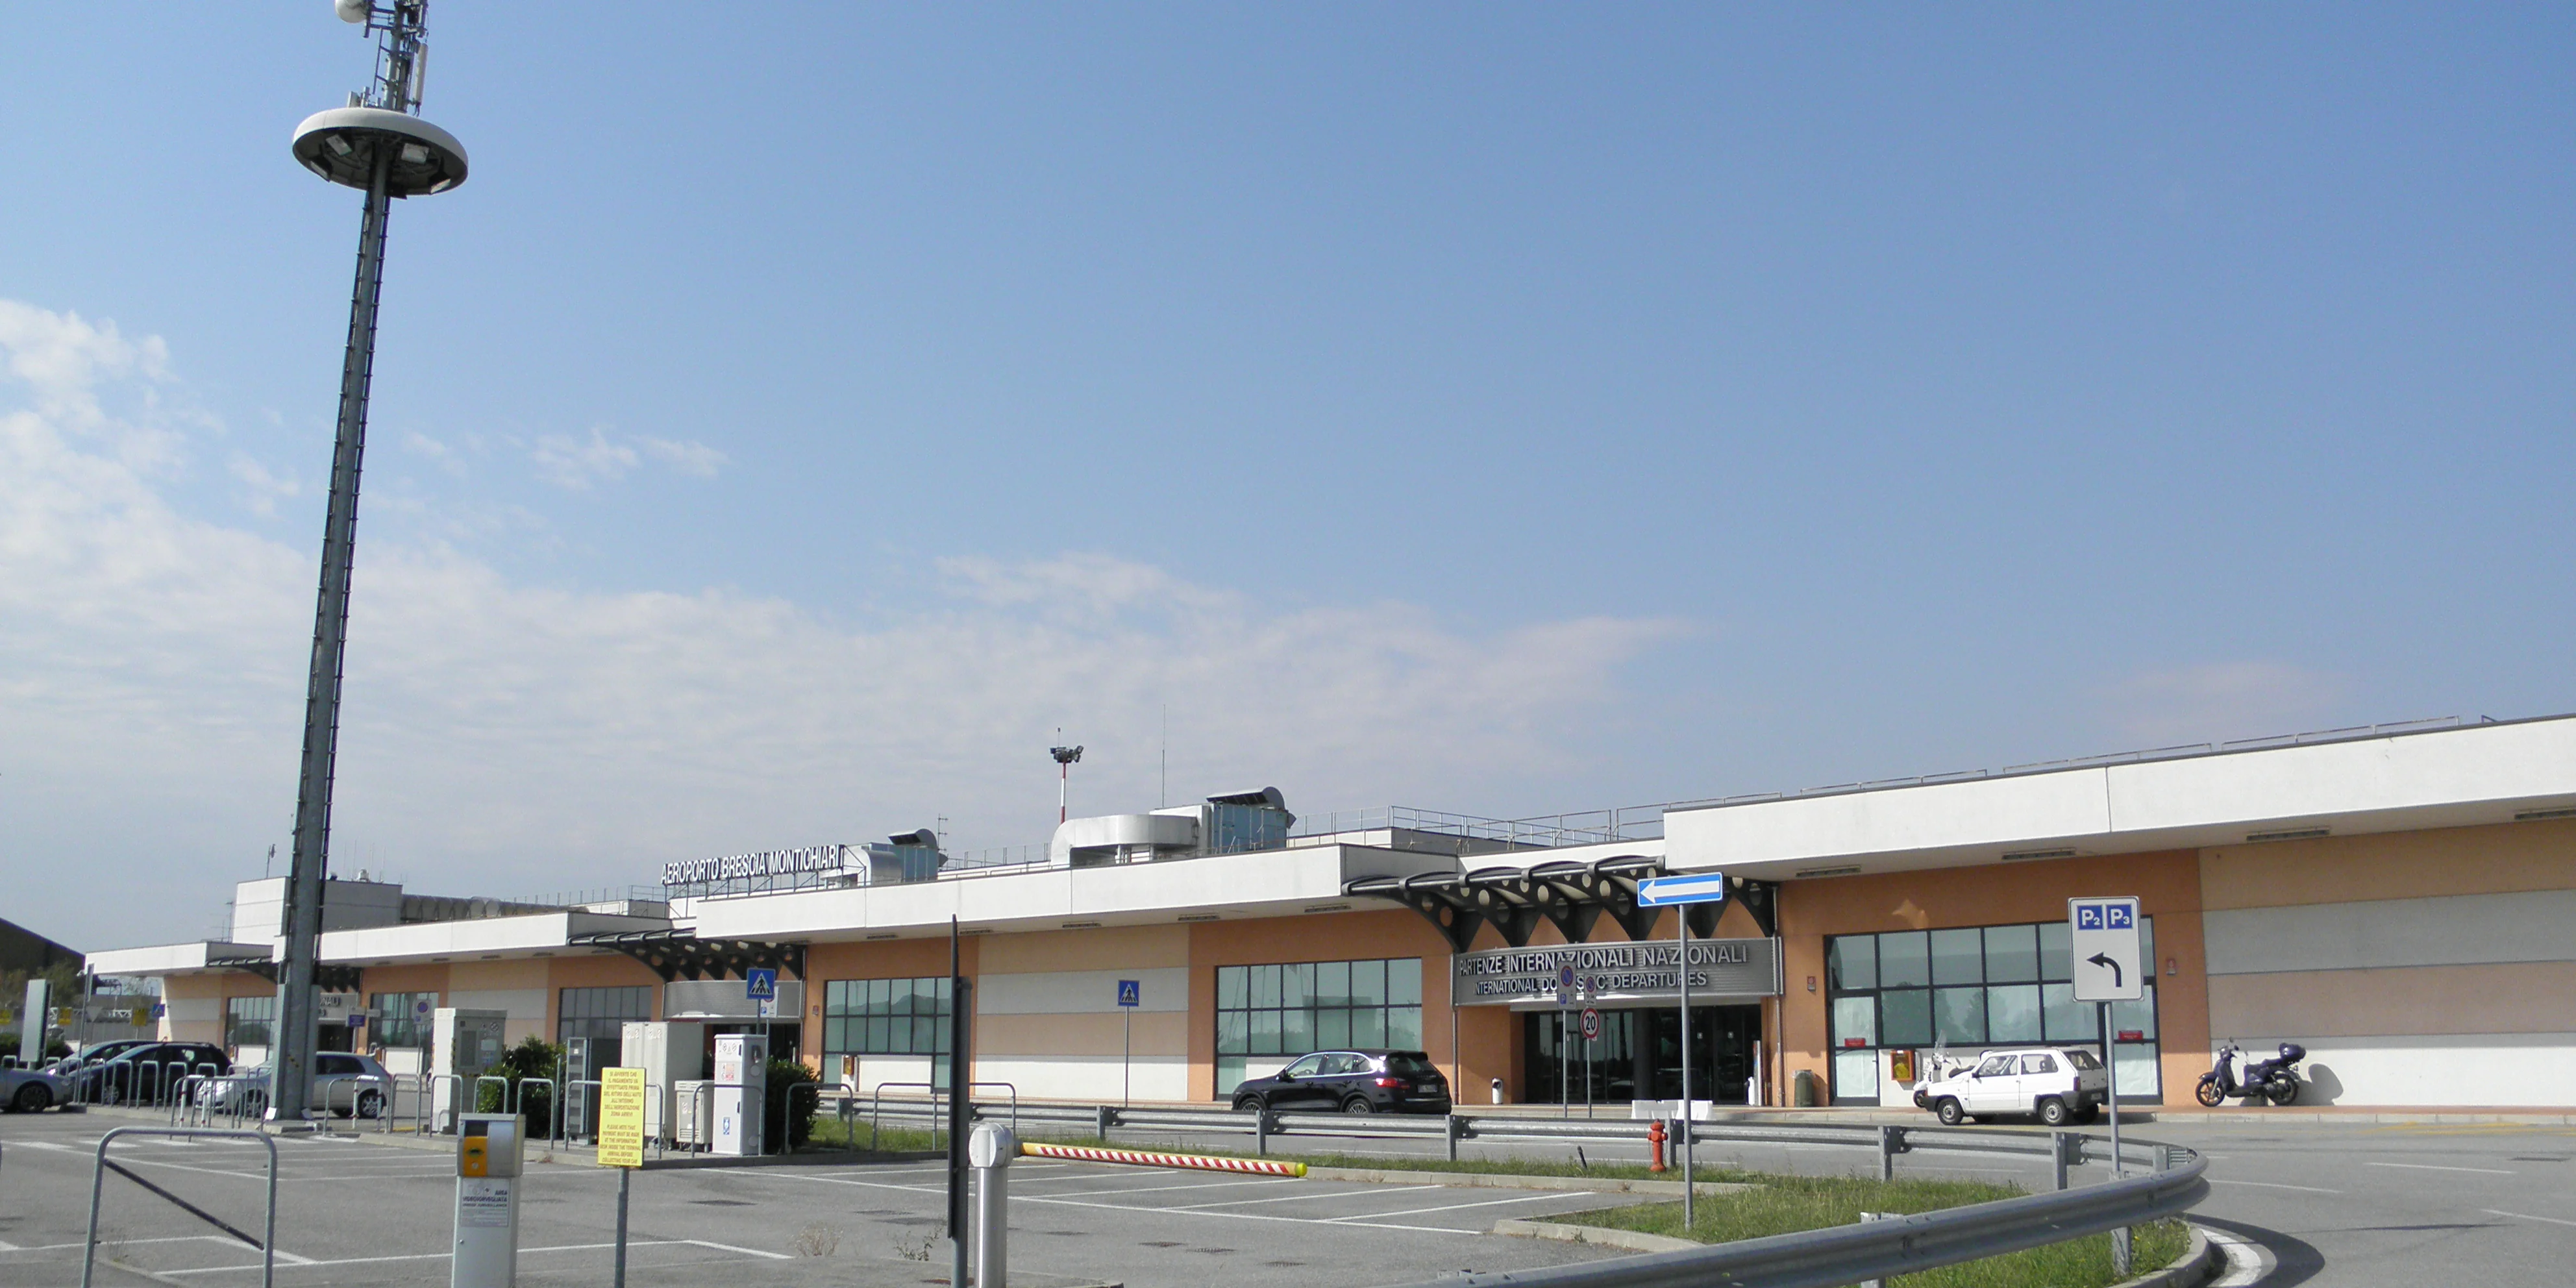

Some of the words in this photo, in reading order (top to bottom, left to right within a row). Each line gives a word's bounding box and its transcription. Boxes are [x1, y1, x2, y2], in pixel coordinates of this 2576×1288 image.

[662, 857, 719, 884] AEROPORTO
[722, 852, 767, 878] BRESCIA
[769, 844, 840, 874] MONTICHIARI
[1460, 956, 1503, 976] PARTENZE
[1643, 945, 1746, 966] NAZONALI
[1474, 978, 1537, 995] INTERNATIONAL
[1585, 1015, 1596, 1030] 20
